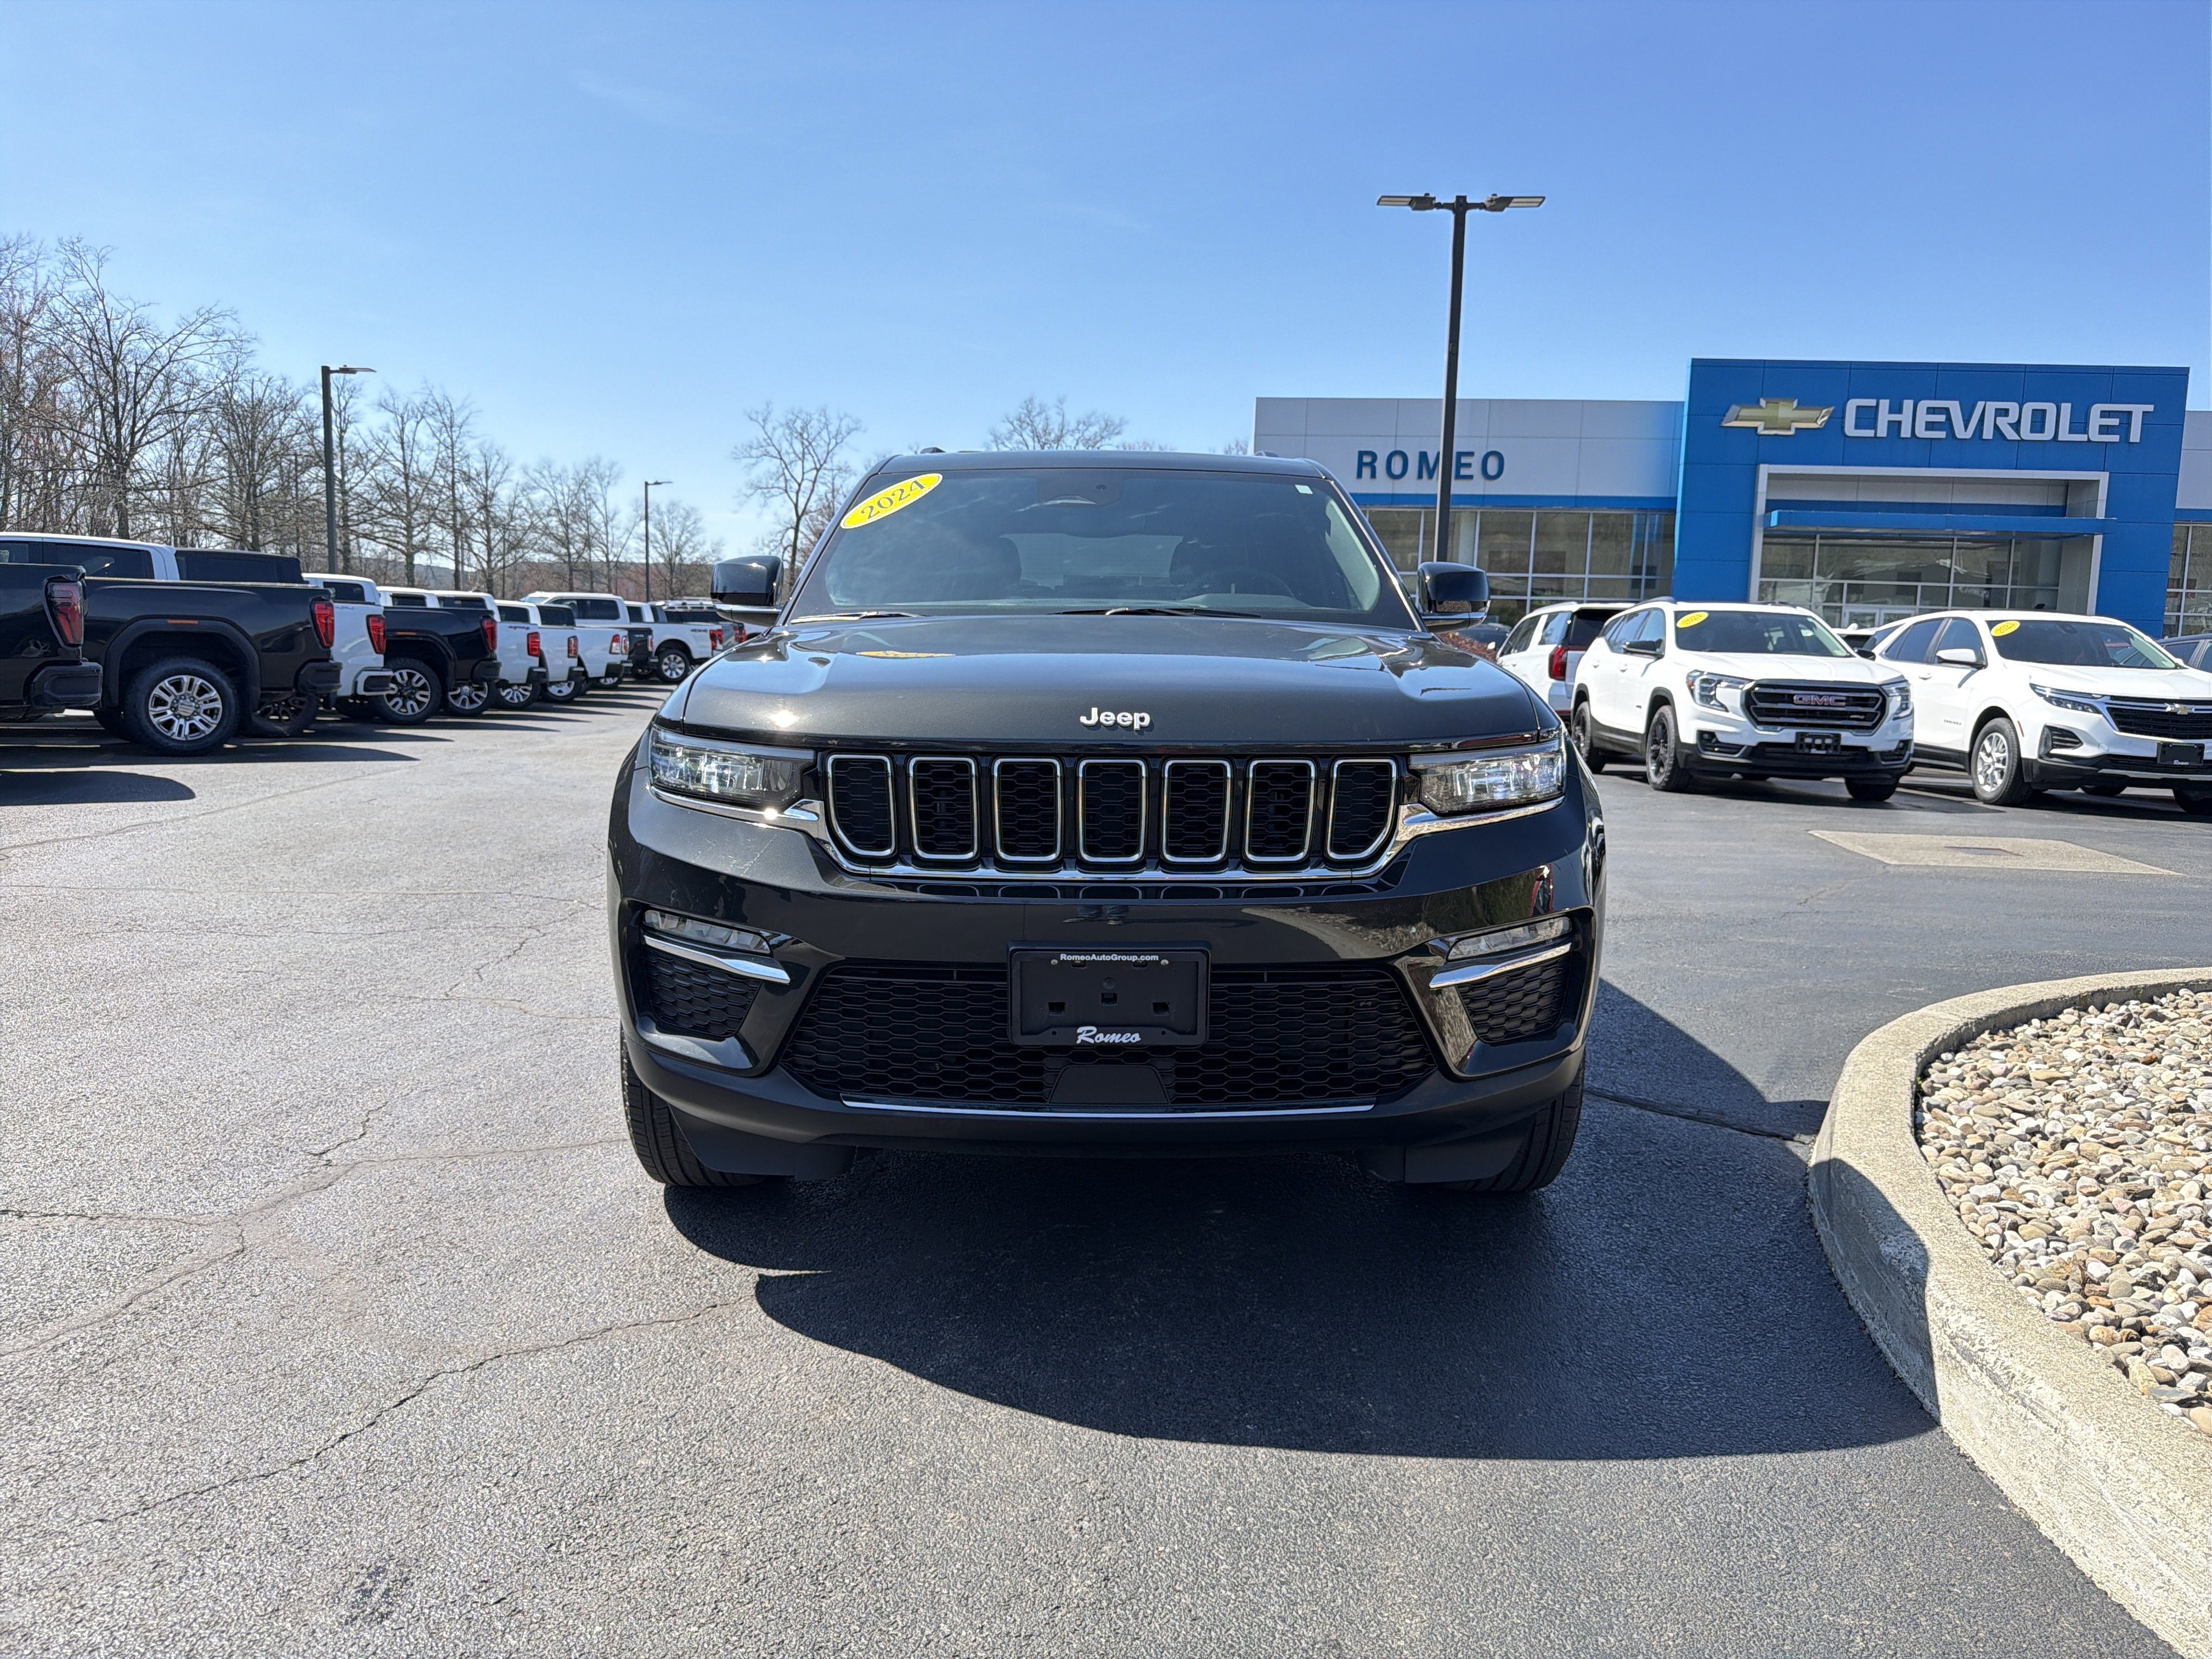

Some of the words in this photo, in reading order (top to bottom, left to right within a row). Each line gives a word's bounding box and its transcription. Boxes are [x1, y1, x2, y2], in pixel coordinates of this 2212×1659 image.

[1844, 398, 2154, 443] CHEVROLET
[1356, 450, 1505, 480] ROMEO
[861, 479, 926, 520] 2024
[1793, 695, 1847, 706] GMC
[1080, 707, 1150, 730] Jeep
[1076, 1026, 1142, 1044] Romeo
